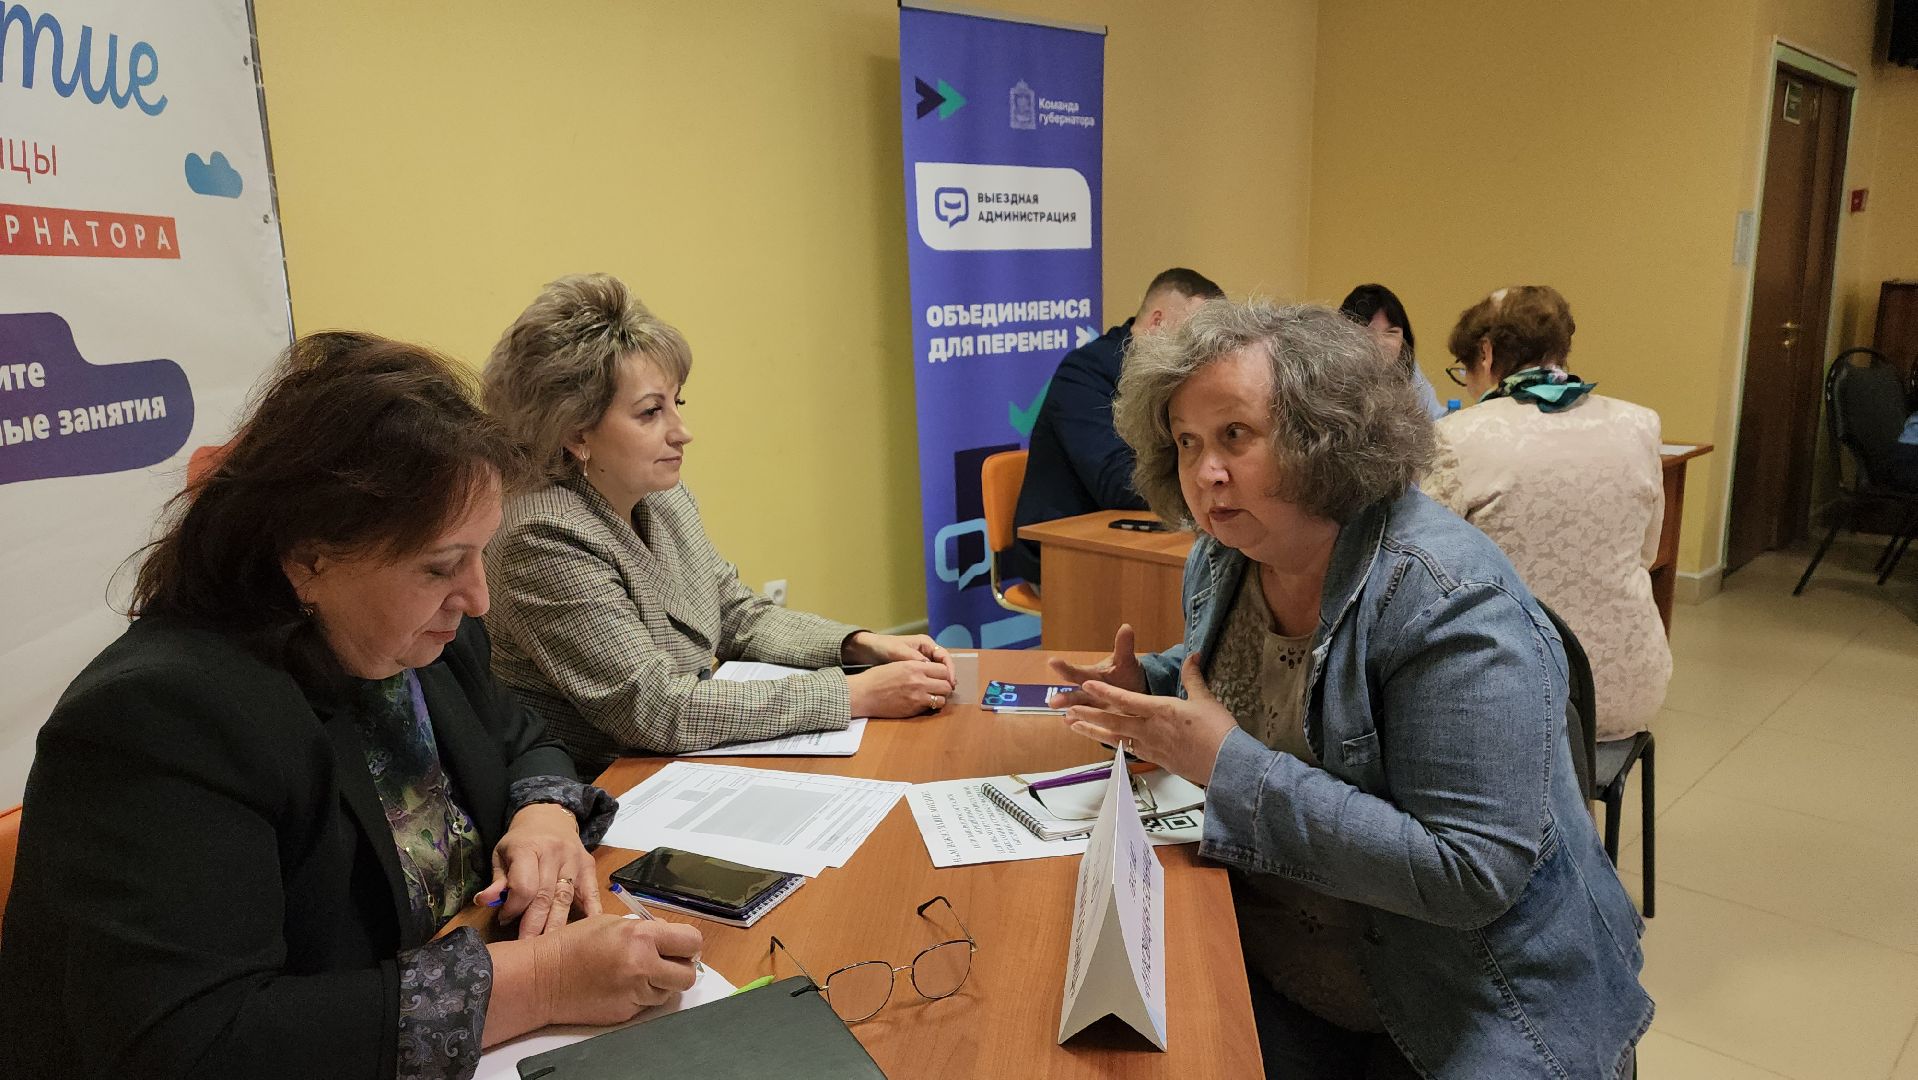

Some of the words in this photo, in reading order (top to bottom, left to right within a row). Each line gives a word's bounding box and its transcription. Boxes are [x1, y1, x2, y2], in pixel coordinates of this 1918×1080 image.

[1038, 98, 1080, 112] Команда
[1038, 112, 1096, 128] губернатора
[0, 137, 57, 184] ЦЫ
[977, 193, 1039, 206] ВЫЕЗДНАЯ
[5, 214, 171, 250] РНАТОРА
[977, 211, 1077, 224] АДМИНИСТРАЦИЯ
[926, 298, 1091, 328] ОБЪЕДИНЯЕМСЯ
[928, 337, 974, 364] ДЛЯ
[977, 328, 1068, 356] ПЕРЕМЕН
[0, 413, 50, 446] ые
[59, 395, 167, 434] занятия
